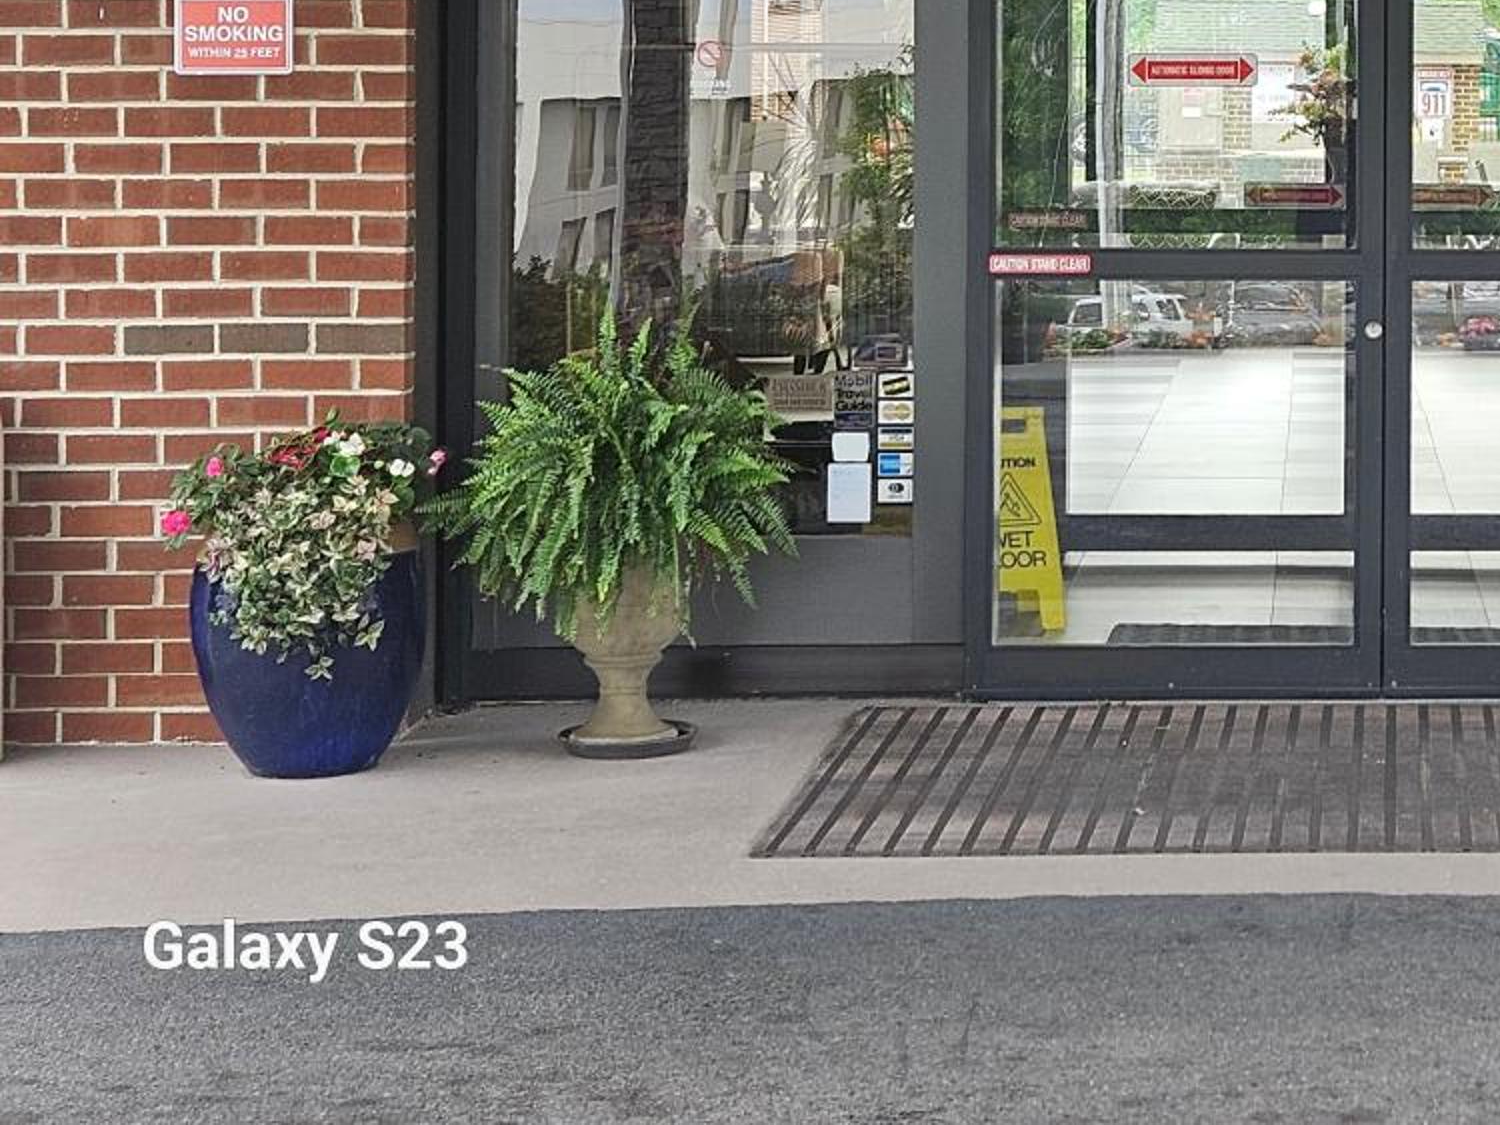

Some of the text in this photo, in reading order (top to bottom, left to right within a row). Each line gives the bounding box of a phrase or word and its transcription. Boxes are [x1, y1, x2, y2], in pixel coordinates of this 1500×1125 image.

[217, 6, 249, 23] NO
[184, 24, 284, 43] SMOKING
[187, 46, 280, 58] WITHIN 25 FEET
[1422, 92, 1447, 115] 911
[993, 258, 1029, 270] CAUTION
[1059, 258, 1087, 270] CLEAR
